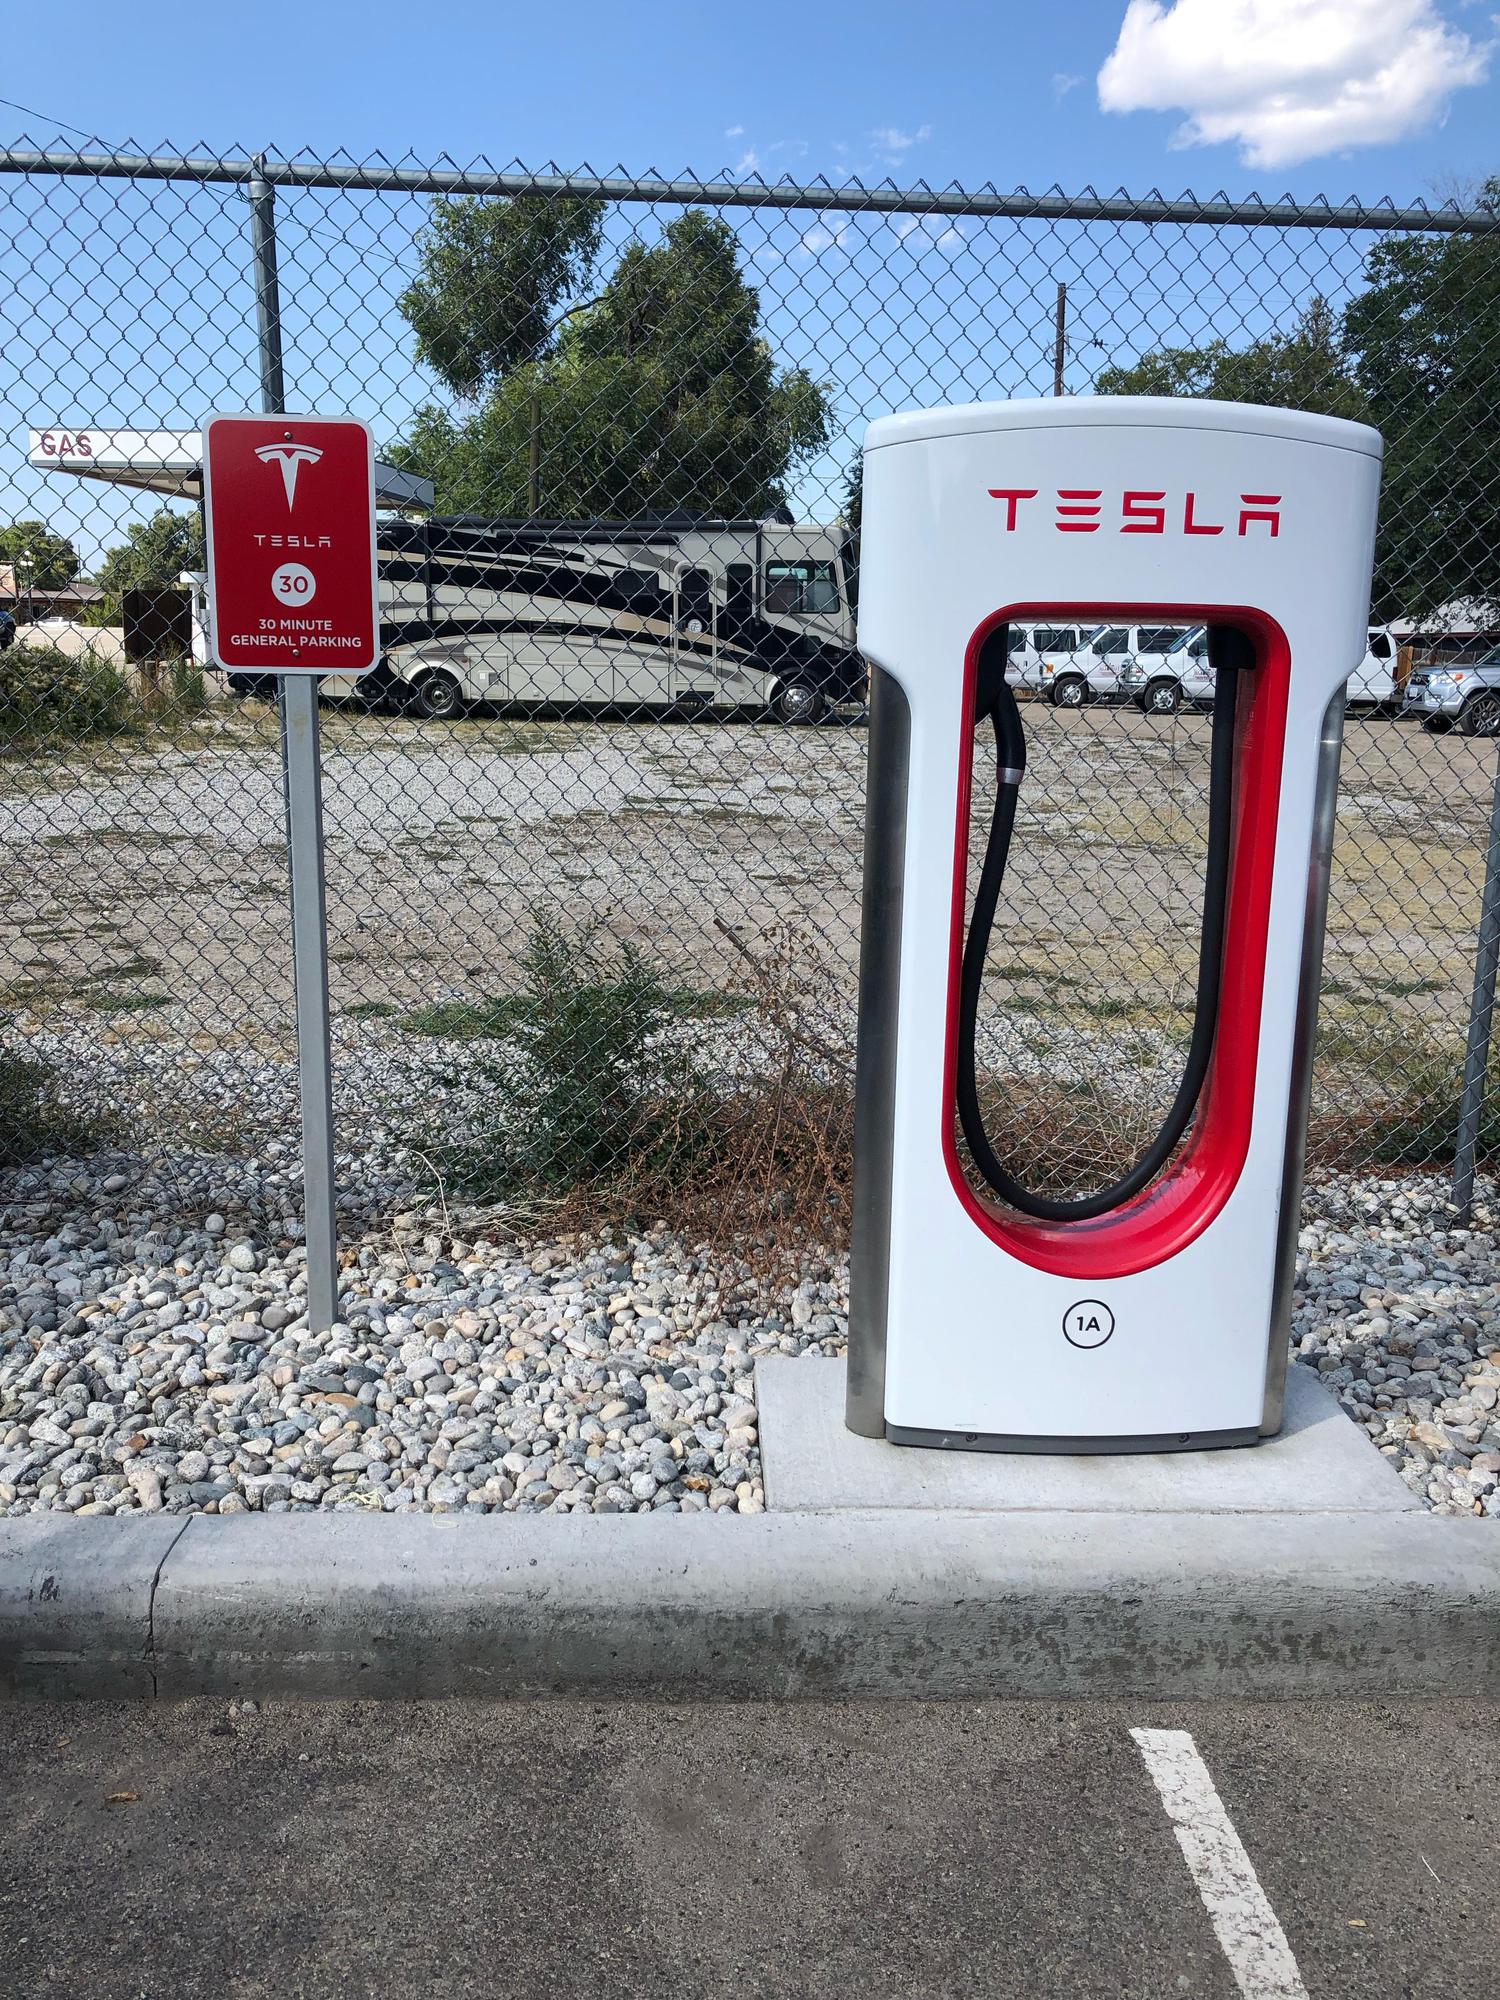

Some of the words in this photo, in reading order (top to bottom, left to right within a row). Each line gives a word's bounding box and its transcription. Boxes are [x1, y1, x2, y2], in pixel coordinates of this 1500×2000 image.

[41, 433, 92, 457] GAS
[987, 488, 1282, 537] TESLA
[253, 534, 331, 548] TESLA
[279, 575, 309, 594] 30
[258, 618, 276, 630] 30
[280, 619, 333, 631] MINUTE
[230, 634, 297, 647] GENERAL
[300, 636, 362, 648] PARKING
[1076, 1316, 1101, 1332] 1A
